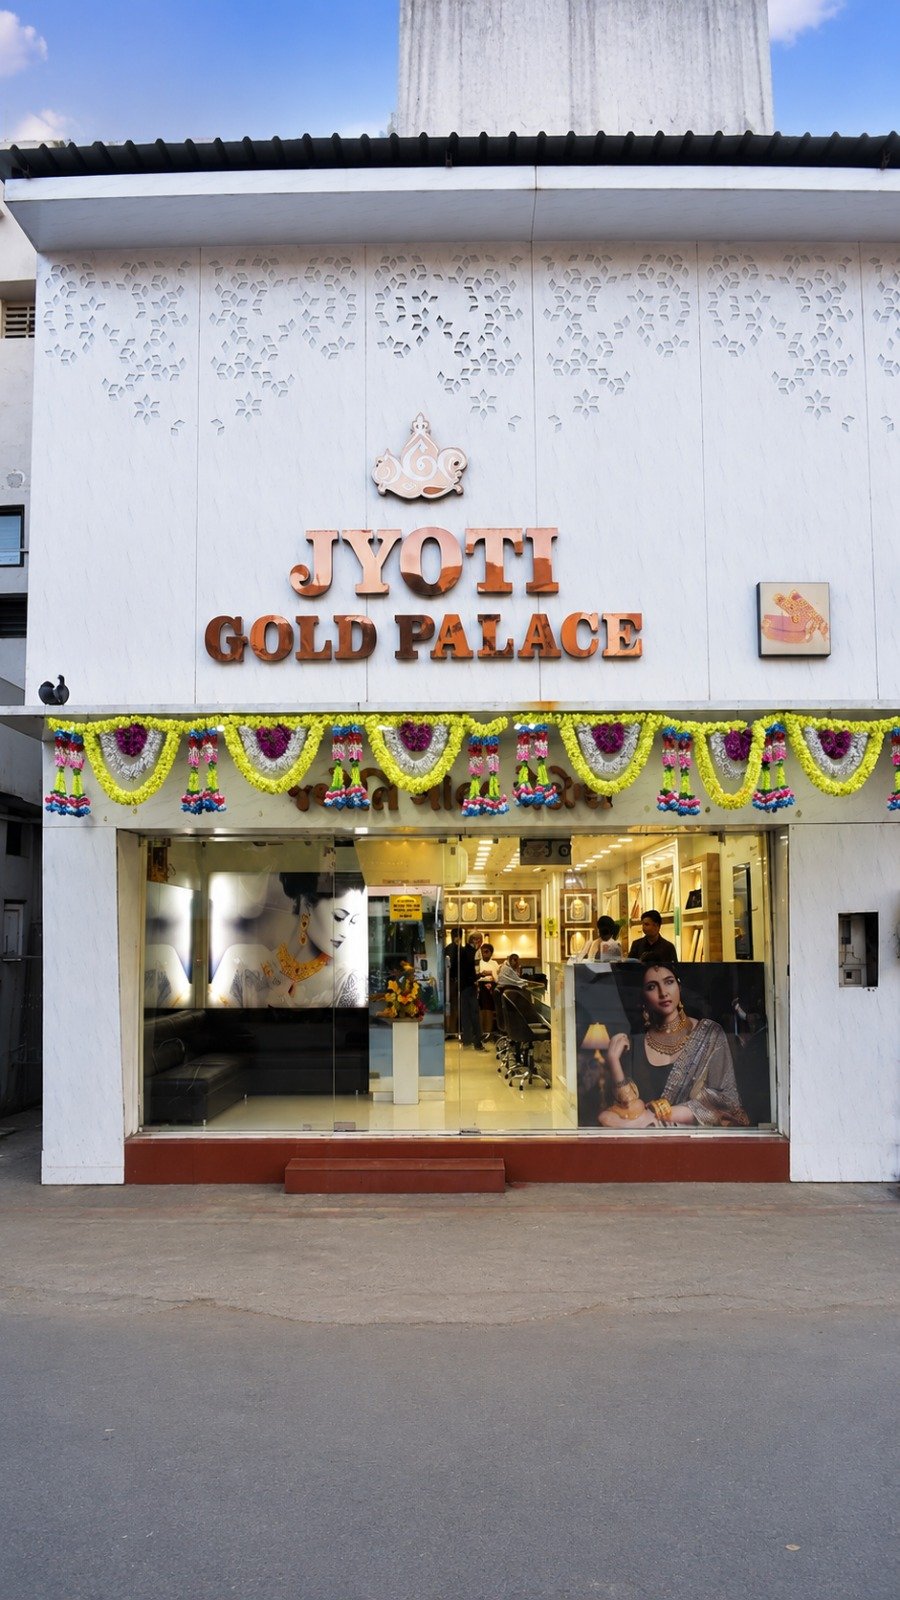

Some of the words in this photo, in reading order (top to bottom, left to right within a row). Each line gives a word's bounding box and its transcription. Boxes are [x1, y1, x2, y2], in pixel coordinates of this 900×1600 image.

[289, 526, 560, 597] JYOTI
[204, 613, 378, 662] GOLD
[394, 611, 644, 660] PALACE
